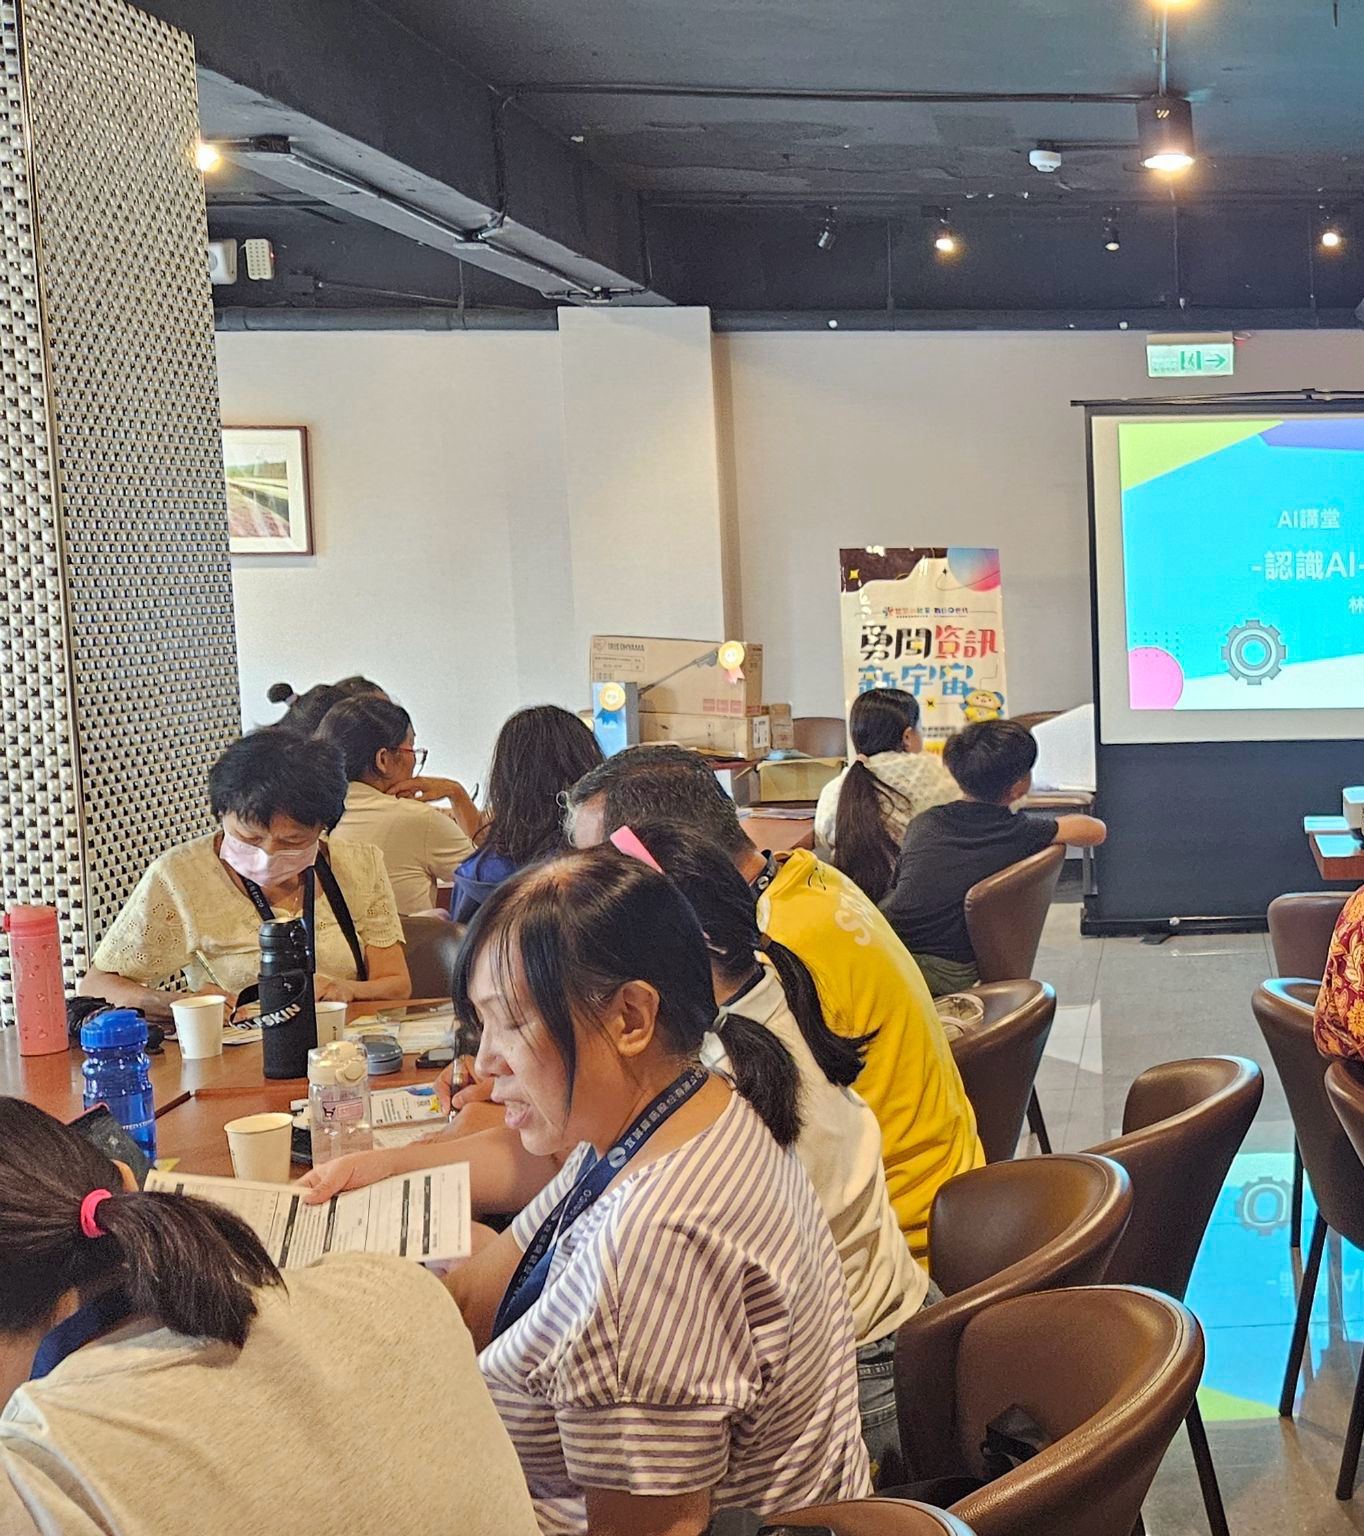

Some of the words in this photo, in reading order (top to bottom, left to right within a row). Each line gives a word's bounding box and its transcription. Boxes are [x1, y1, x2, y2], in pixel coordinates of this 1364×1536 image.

[1277, 508, 1341, 530] AI講堂
[858, 663, 974, 697] 新宇宙
[235, 1002, 302, 1031] OLESKIN
